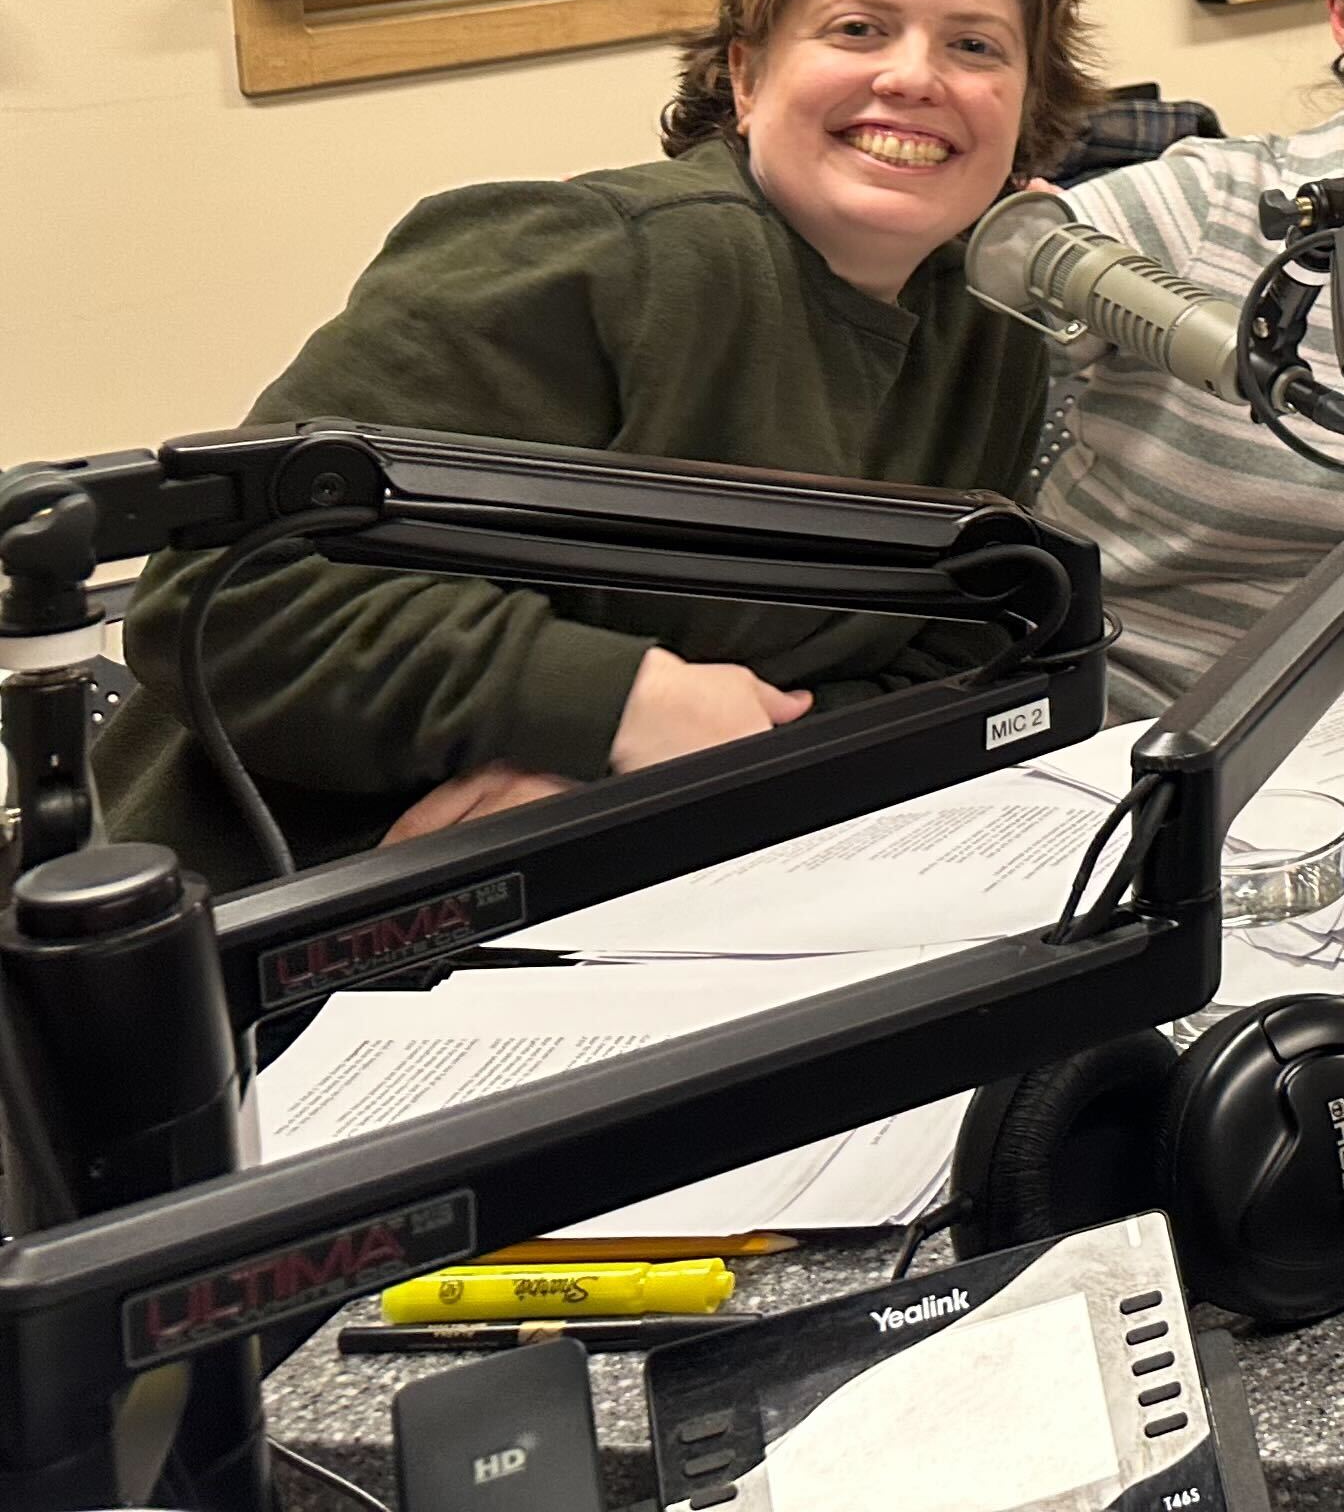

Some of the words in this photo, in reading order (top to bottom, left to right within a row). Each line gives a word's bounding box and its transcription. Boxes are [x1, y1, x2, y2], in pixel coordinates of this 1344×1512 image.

[992, 714, 1027, 741] MIC
[1031, 708, 1043, 727] 2
[274, 896, 472, 988] ULTIMA
[144, 1220, 408, 1342] ULTIMA
[869, 1288, 970, 1332] Yealink
[473, 1447, 527, 1485] HD
[1163, 1487, 1201, 1512] T46S
